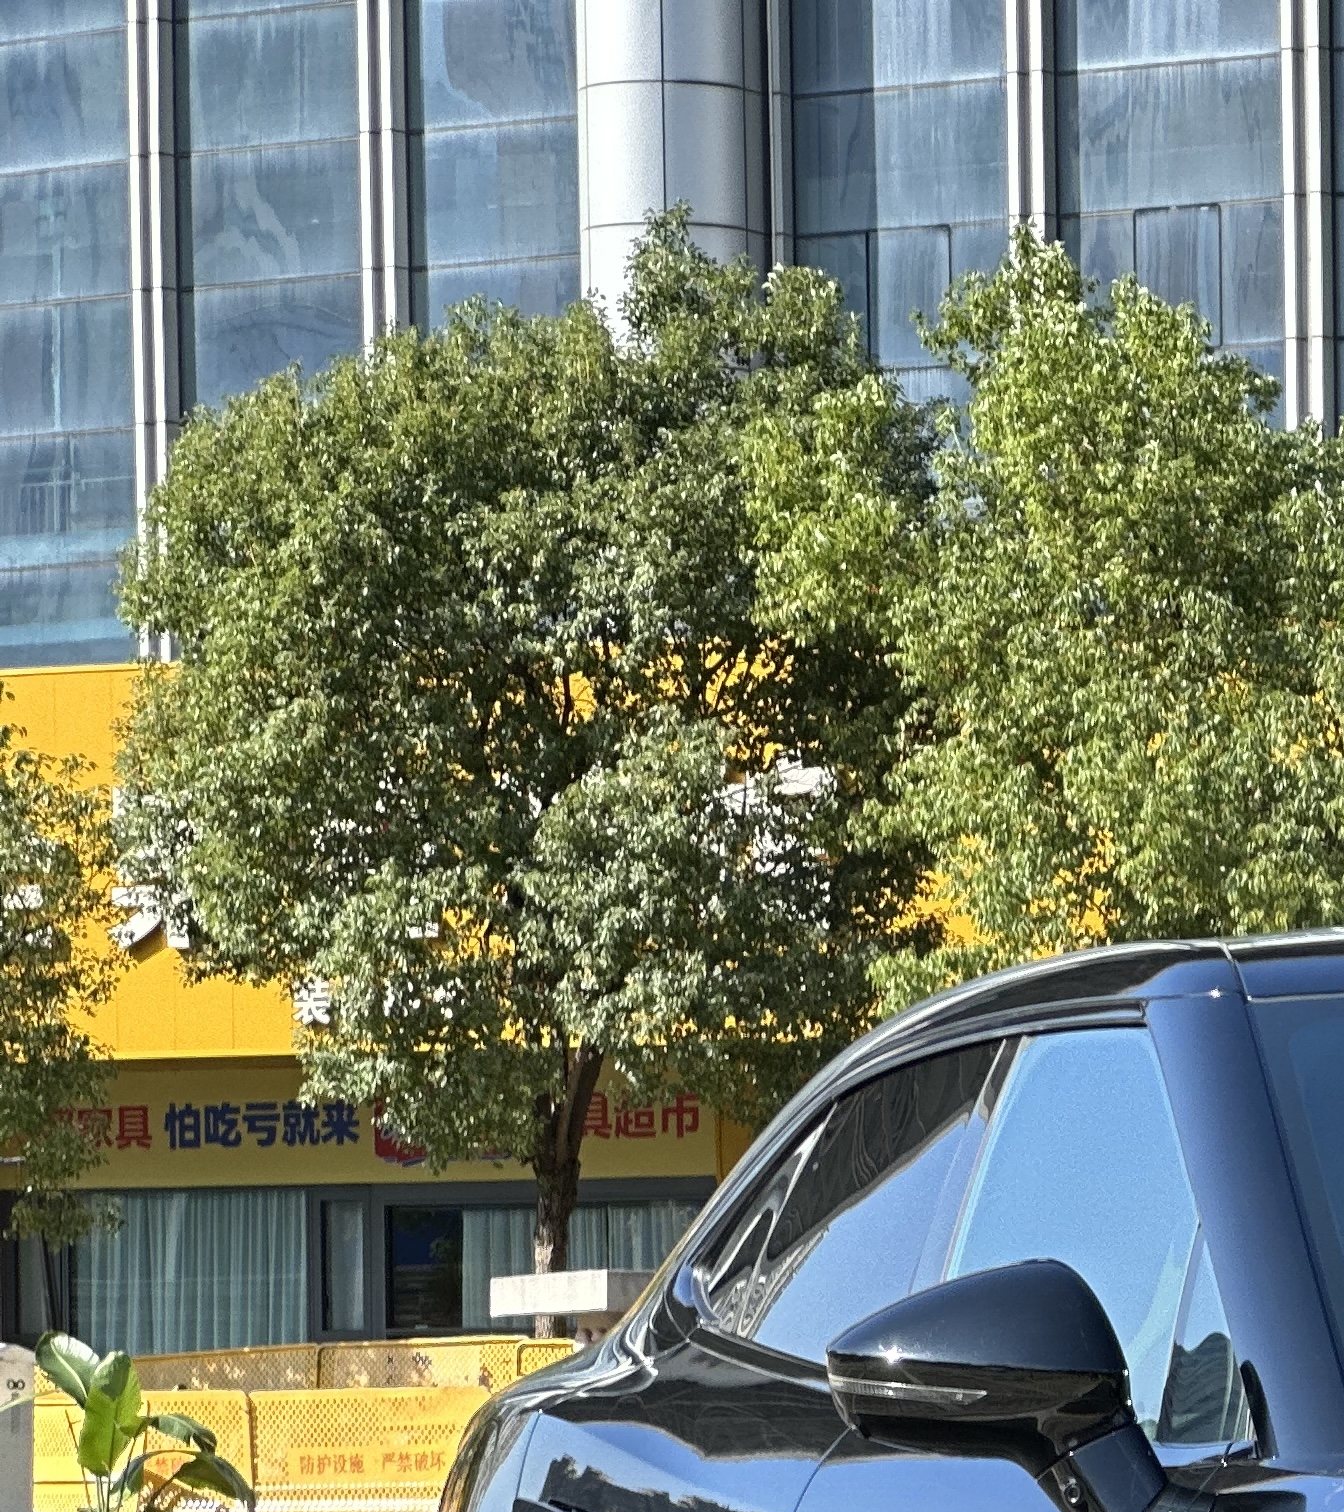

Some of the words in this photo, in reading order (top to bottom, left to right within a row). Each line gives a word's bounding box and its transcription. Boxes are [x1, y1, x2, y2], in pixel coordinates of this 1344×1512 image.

[164, 1100, 360, 1150] 怕吃亏就来
